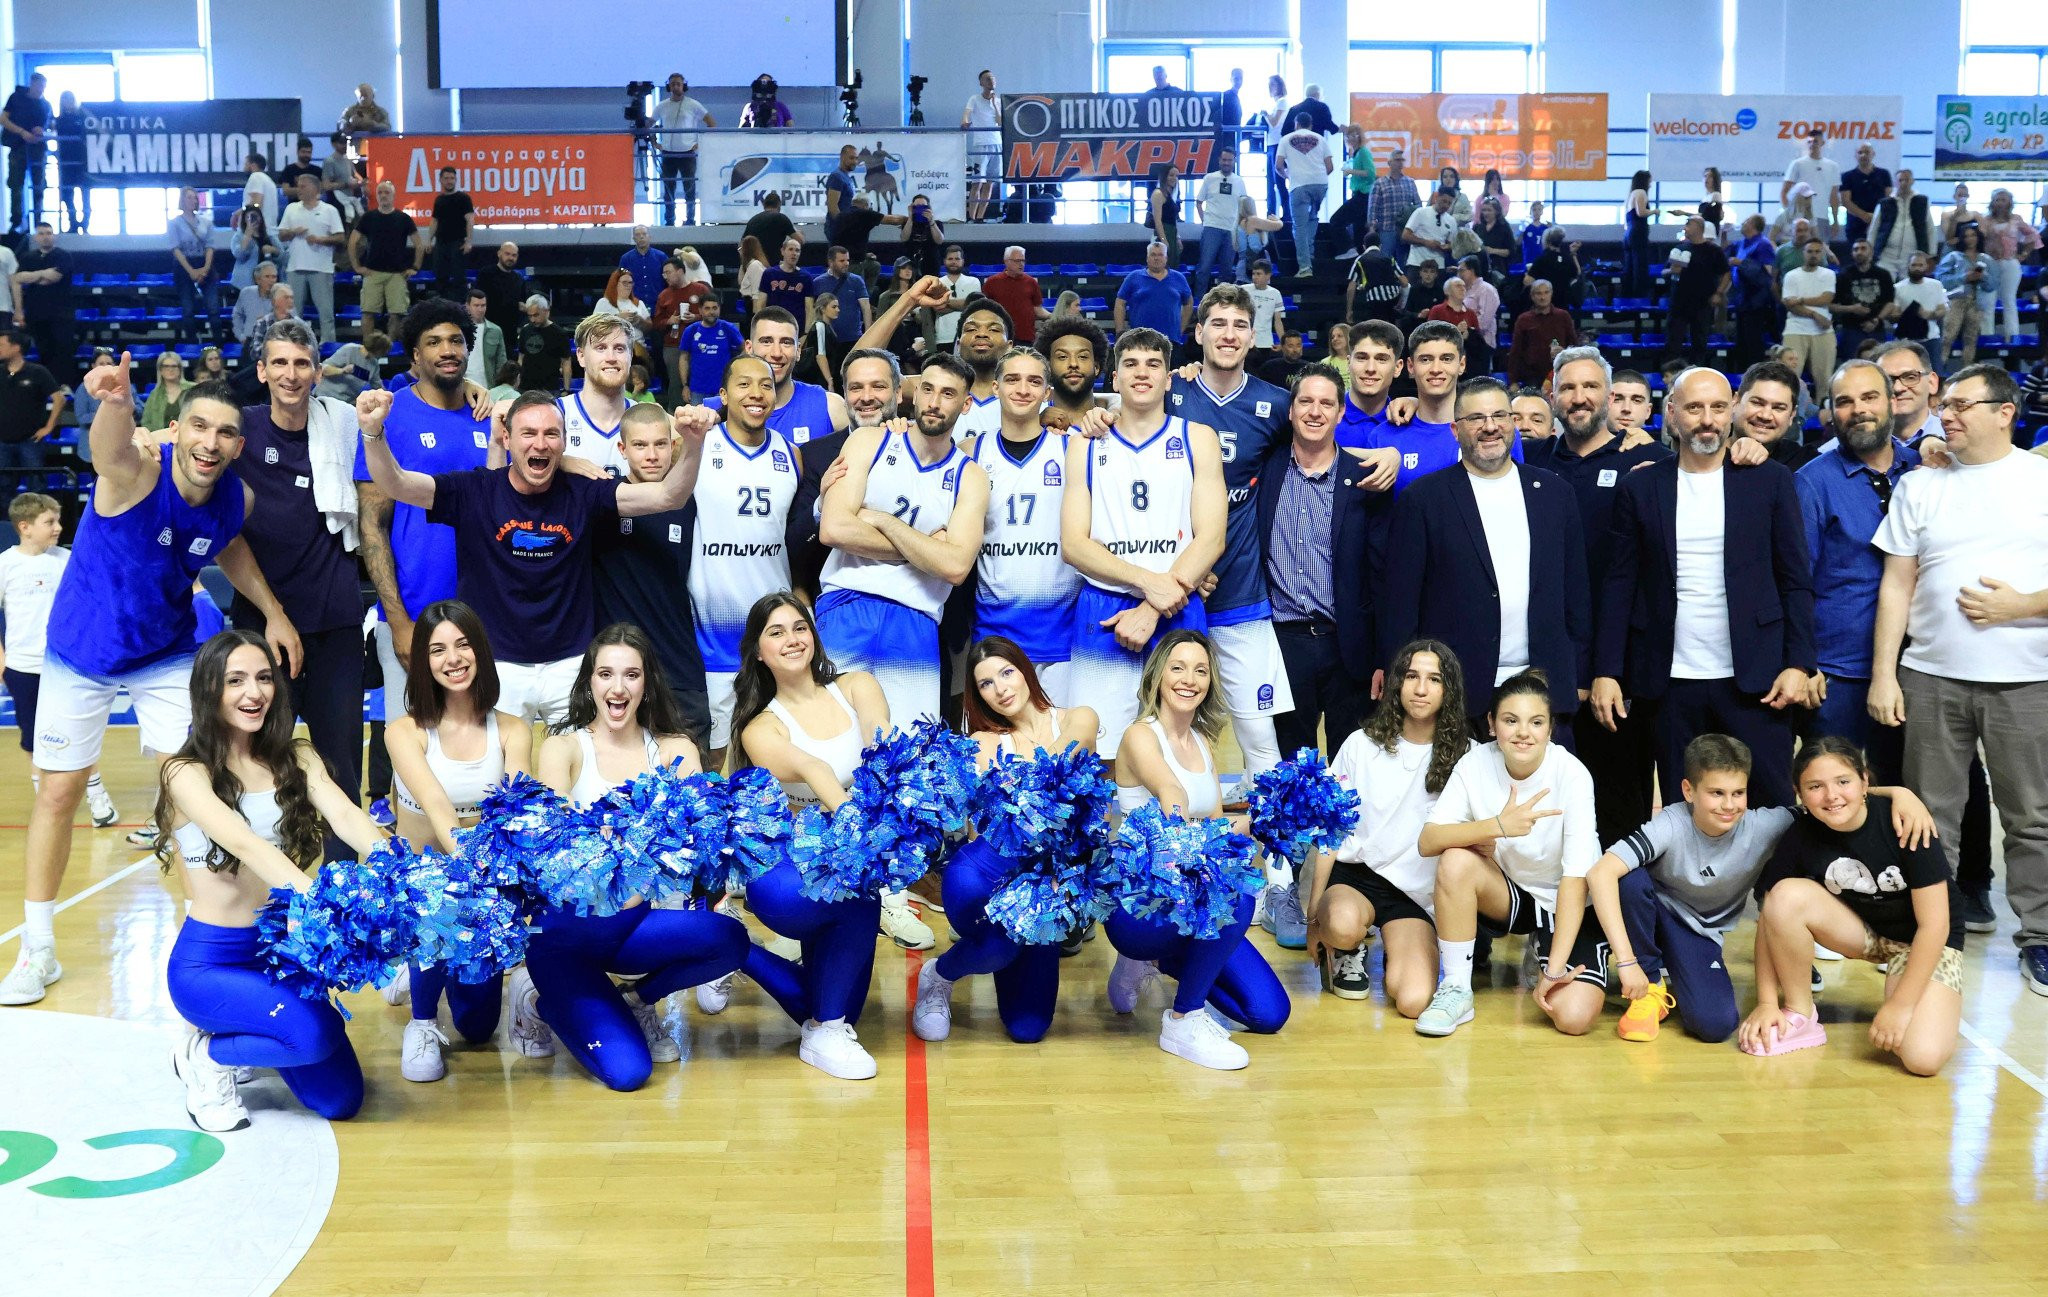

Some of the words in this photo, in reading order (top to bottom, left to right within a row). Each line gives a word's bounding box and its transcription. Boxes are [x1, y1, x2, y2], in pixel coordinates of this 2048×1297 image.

[85, 117, 165, 130] ΟΠΤΙΚΑ
[1148, 97, 1214, 128] ΟΙΚΟΣ
[1653, 118, 1741, 136] welcome
[1006, 138, 1215, 178] ΜΑΚΡΗ
[553, 205, 616, 215] ΚΑΡΔΙΤΣΑ
[1219, 431, 1237, 463] 5
[738, 486, 771, 517] 25
[894, 495, 921, 527] 21
[1006, 493, 1037, 526] 17
[1131, 480, 1149, 512] 8
